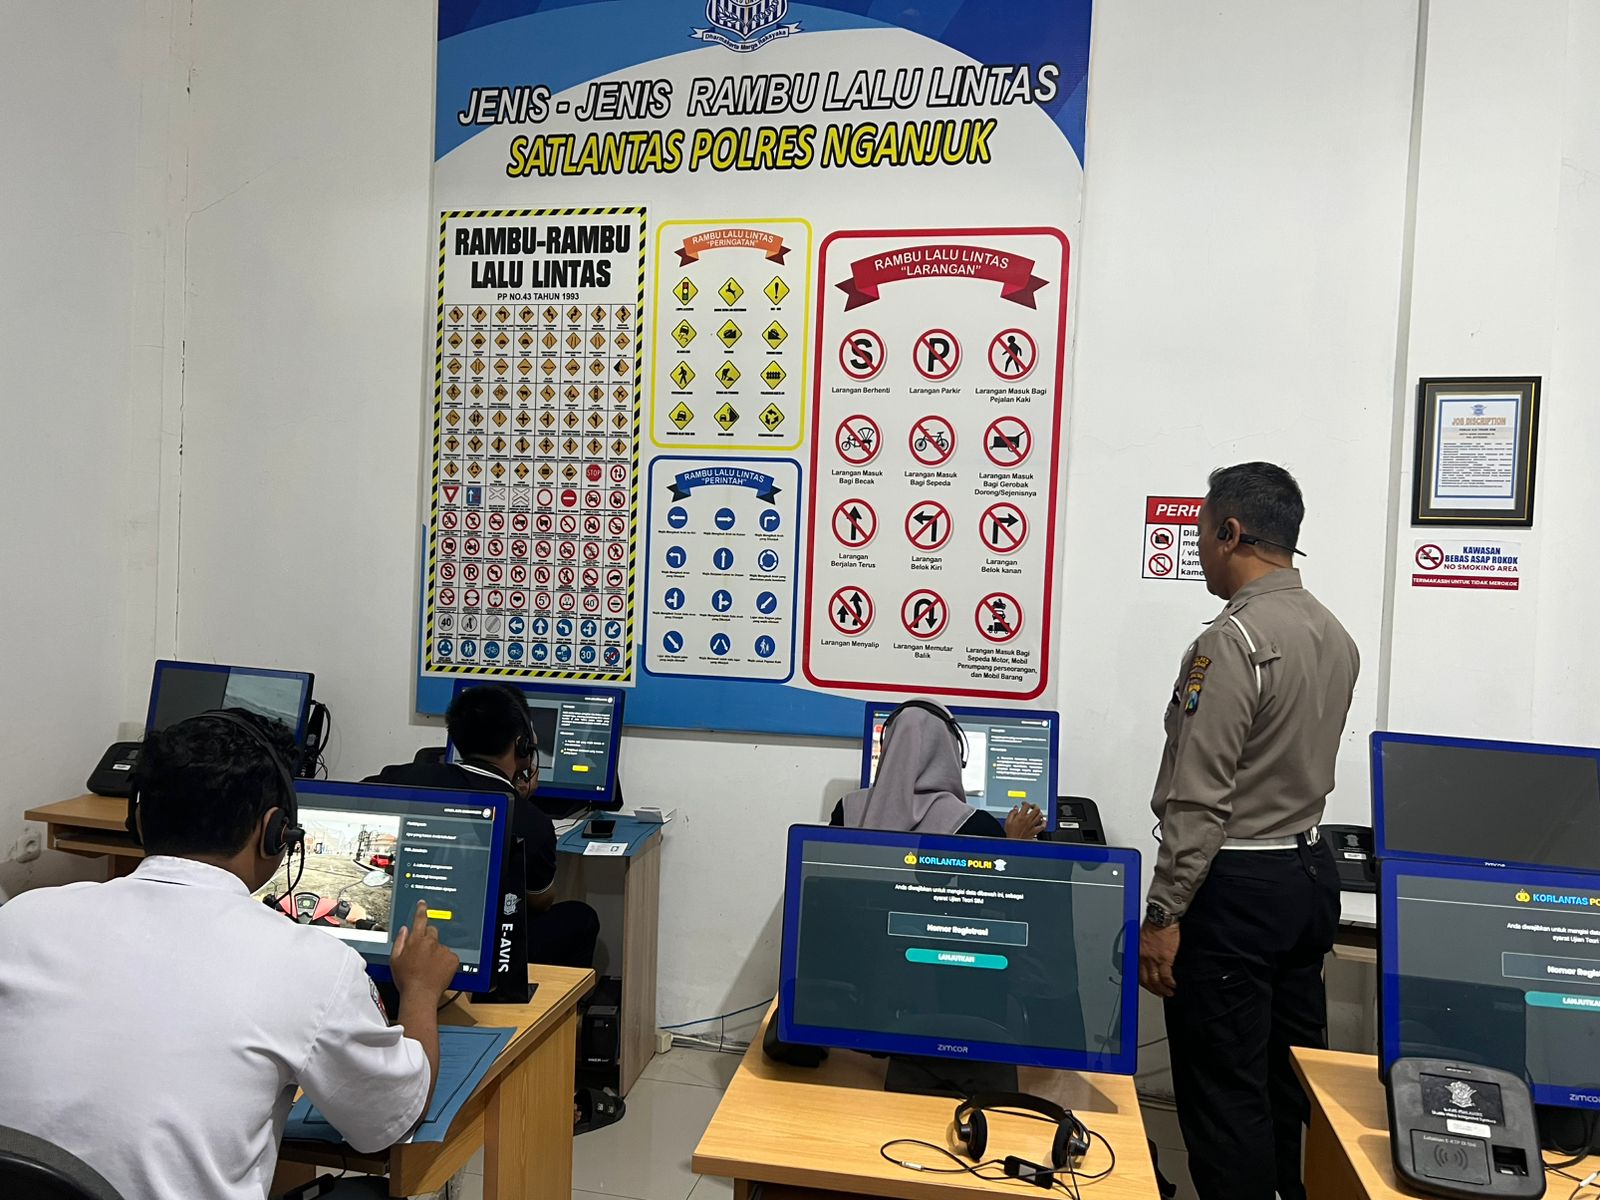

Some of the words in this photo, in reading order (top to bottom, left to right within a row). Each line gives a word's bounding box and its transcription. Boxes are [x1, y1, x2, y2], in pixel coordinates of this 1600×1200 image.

[458, 84, 552, 126] JENIS
[575, 78, 673, 121] JENIS
[687, 72, 819, 117] RAMBU
[823, 67, 923, 111] LALU
[926, 63, 1061, 108] LINTAS
[506, 129, 685, 177] SATLANTAS
[689, 124, 817, 173] POLRES
[820, 118, 998, 168] NGANJUK
[455, 225, 631, 255] RAMBU-RAMBU
[692, 231, 722, 245] RAMBU
[723, 230, 744, 238] LALU
[745, 231, 774, 244] LINTAS
[874, 251, 922, 270] RAMBU
[925, 249, 959, 261] LALU
[962, 250, 1010, 269] LINTAS
[471, 260, 523, 289] LALU
[532, 259, 612, 288] LINTAS
[509, 293, 532, 301] NO.43
[831, 386, 861, 394] Larangan
[909, 387, 938, 395] Larangan
[975, 388, 1007, 396] Larangan
[1031, 388, 1047, 396] Bagi
[990, 396, 1015, 404] Pejalan
[586, 467, 601, 477] STOP
[684, 470, 713, 481] RAMBU
[736, 470, 765, 483] LINTAS
[831, 469, 861, 477] Larangan
[904, 471, 934, 479] Larangan
[979, 472, 1010, 480] Larangan
[910, 479, 925, 487] Bagi
[926, 479, 951, 487] Sepeda
[983, 480, 998, 488] Bagi
[974, 489, 1037, 497] Dorong/Sejenisnya
[1463, 546, 1501, 555] KAWASAN
[838, 553, 869, 561] Larangan
[911, 555, 942, 563] Larangan
[1445, 555, 1469, 563] BEBAS
[1470, 555, 1491, 564] ASAP
[1491, 556, 1518, 565] ROKOK
[986, 558, 1018, 566] Larangan
[821, 639, 851, 647] Larangan
[852, 640, 880, 648] Menyalip
[893, 643, 924, 651] Larangan
[965, 647, 995, 655] Larangan
[995, 648, 1015, 656] Masuk
[1016, 649, 1030, 657] Bagi
[967, 655, 990, 663] Sepeda
[991, 656, 1010, 664] Motor,
[957, 663, 992, 672] Penumpang
[993, 666, 1038, 674] perseorangan,
[1000, 673, 1023, 682] Barang
[919, 856, 967, 868] KORLANTAS
[967, 859, 992, 869] POLRI
[1532, 893, 1589, 905] KORLANTAS
[497, 923, 514, 973] E-AVIS
